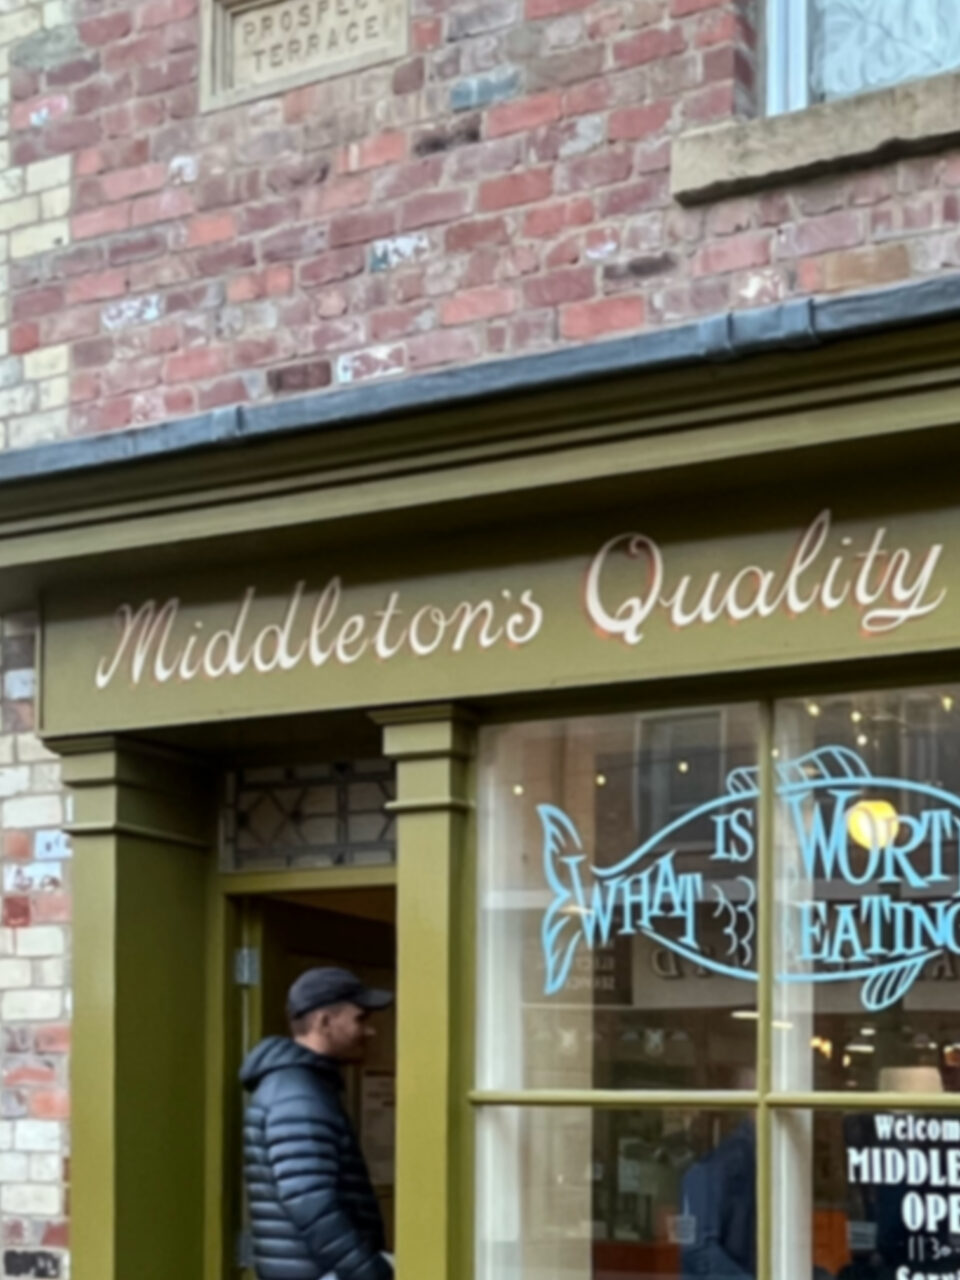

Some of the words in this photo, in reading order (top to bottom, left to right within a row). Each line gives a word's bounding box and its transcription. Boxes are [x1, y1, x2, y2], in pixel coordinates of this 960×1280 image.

[252, 15, 380, 73] TERRACE
[96, 576, 543, 690] Middleton's
[585, 508, 946, 646] Quality
[709, 808, 755, 862] IS
[560, 850, 703, 950] WHAT
